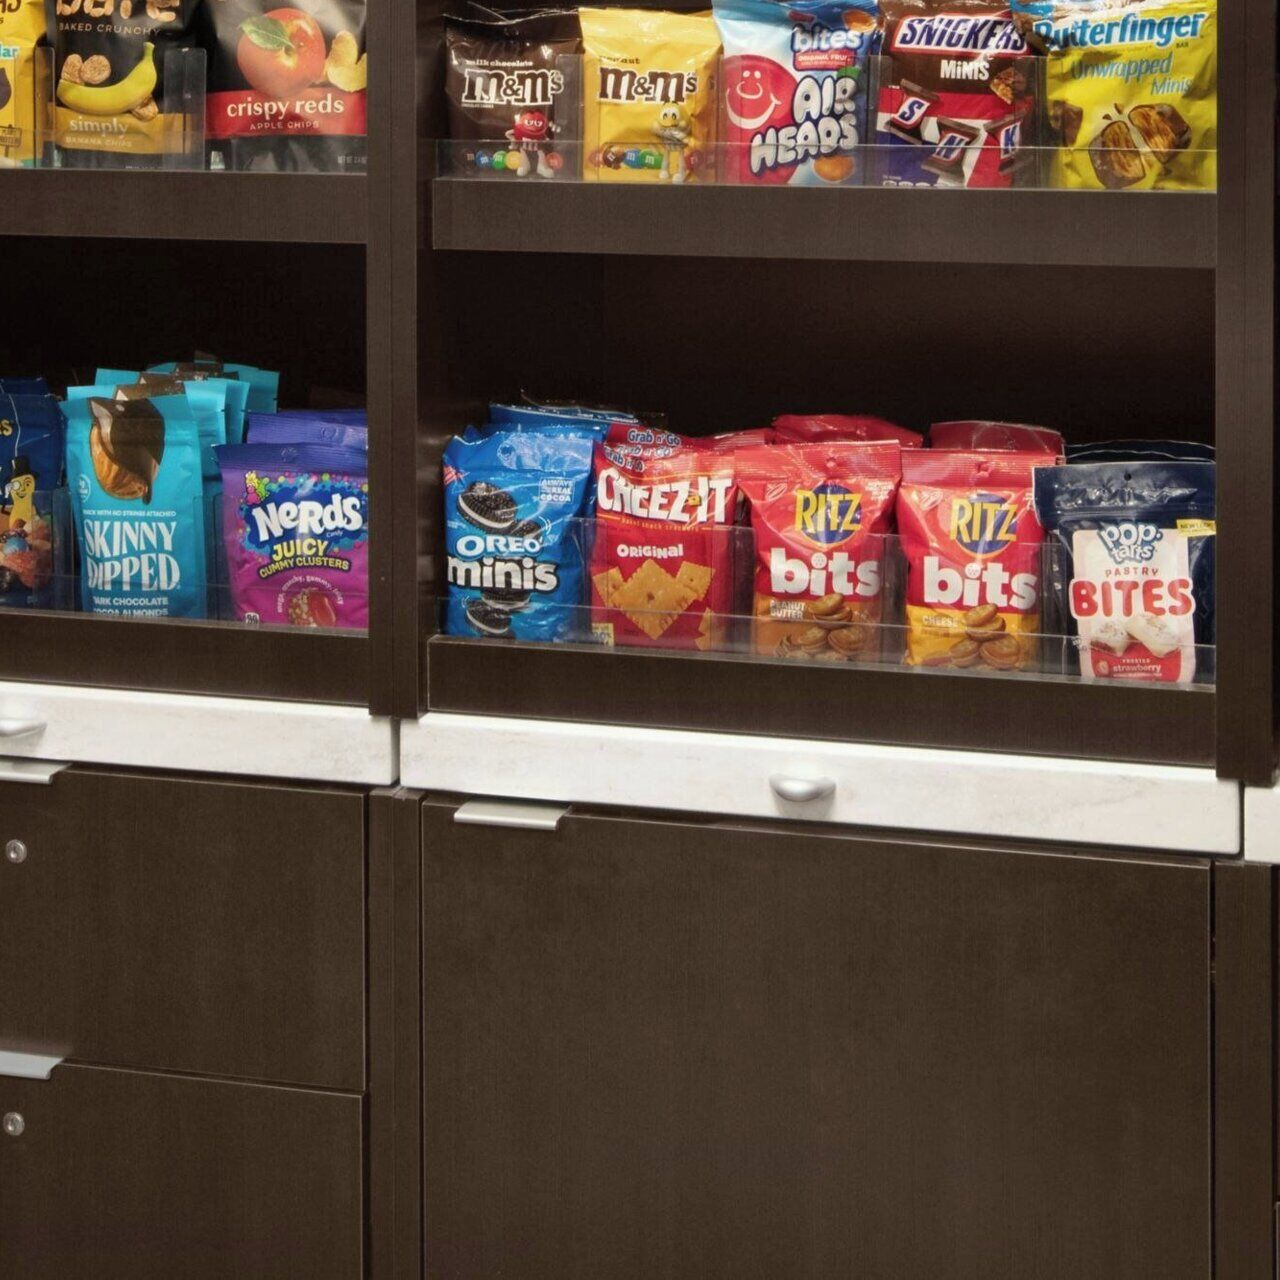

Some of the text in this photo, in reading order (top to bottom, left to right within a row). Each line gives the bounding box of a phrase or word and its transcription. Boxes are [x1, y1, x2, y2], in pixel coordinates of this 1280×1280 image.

[60, 22, 161, 36] BAKED CRUNCHY
[793, 24, 861, 51] bites
[899, 16, 1026, 52] SNICKERS
[1070, 52, 1173, 86] Unwrapped
[793, 74, 858, 124] AIR
[1151, 77, 1192, 97] Minis
[226, 93, 345, 126] crispy reds
[69, 116, 129, 138] simply
[250, 120, 319, 131] APPLE CHIPS
[750, 114, 860, 176] HEADS
[628, 429, 654, 444] Grab
[795, 488, 863, 535] RITZ
[949, 498, 1018, 544] RITZ
[83, 519, 177, 558] SKINNY
[272, 537, 328, 561] JUICY
[456, 535, 540, 558] OREO
[295, 556, 350, 570] CLUSTERS
[1113, 543, 1155, 562] tarts
[87, 553, 181, 591] DIPPED
[447, 558, 558, 592] minis
[770, 547, 881, 598] bits
[923, 556, 1038, 609] bits
[1105, 566, 1160, 577] PASTRY
[112, 596, 169, 606] CHOCOLATE
[769, 600, 806, 612] PEANUT
[1072, 578, 1193, 618] BITES
[1113, 664, 1162, 673] strawberry
